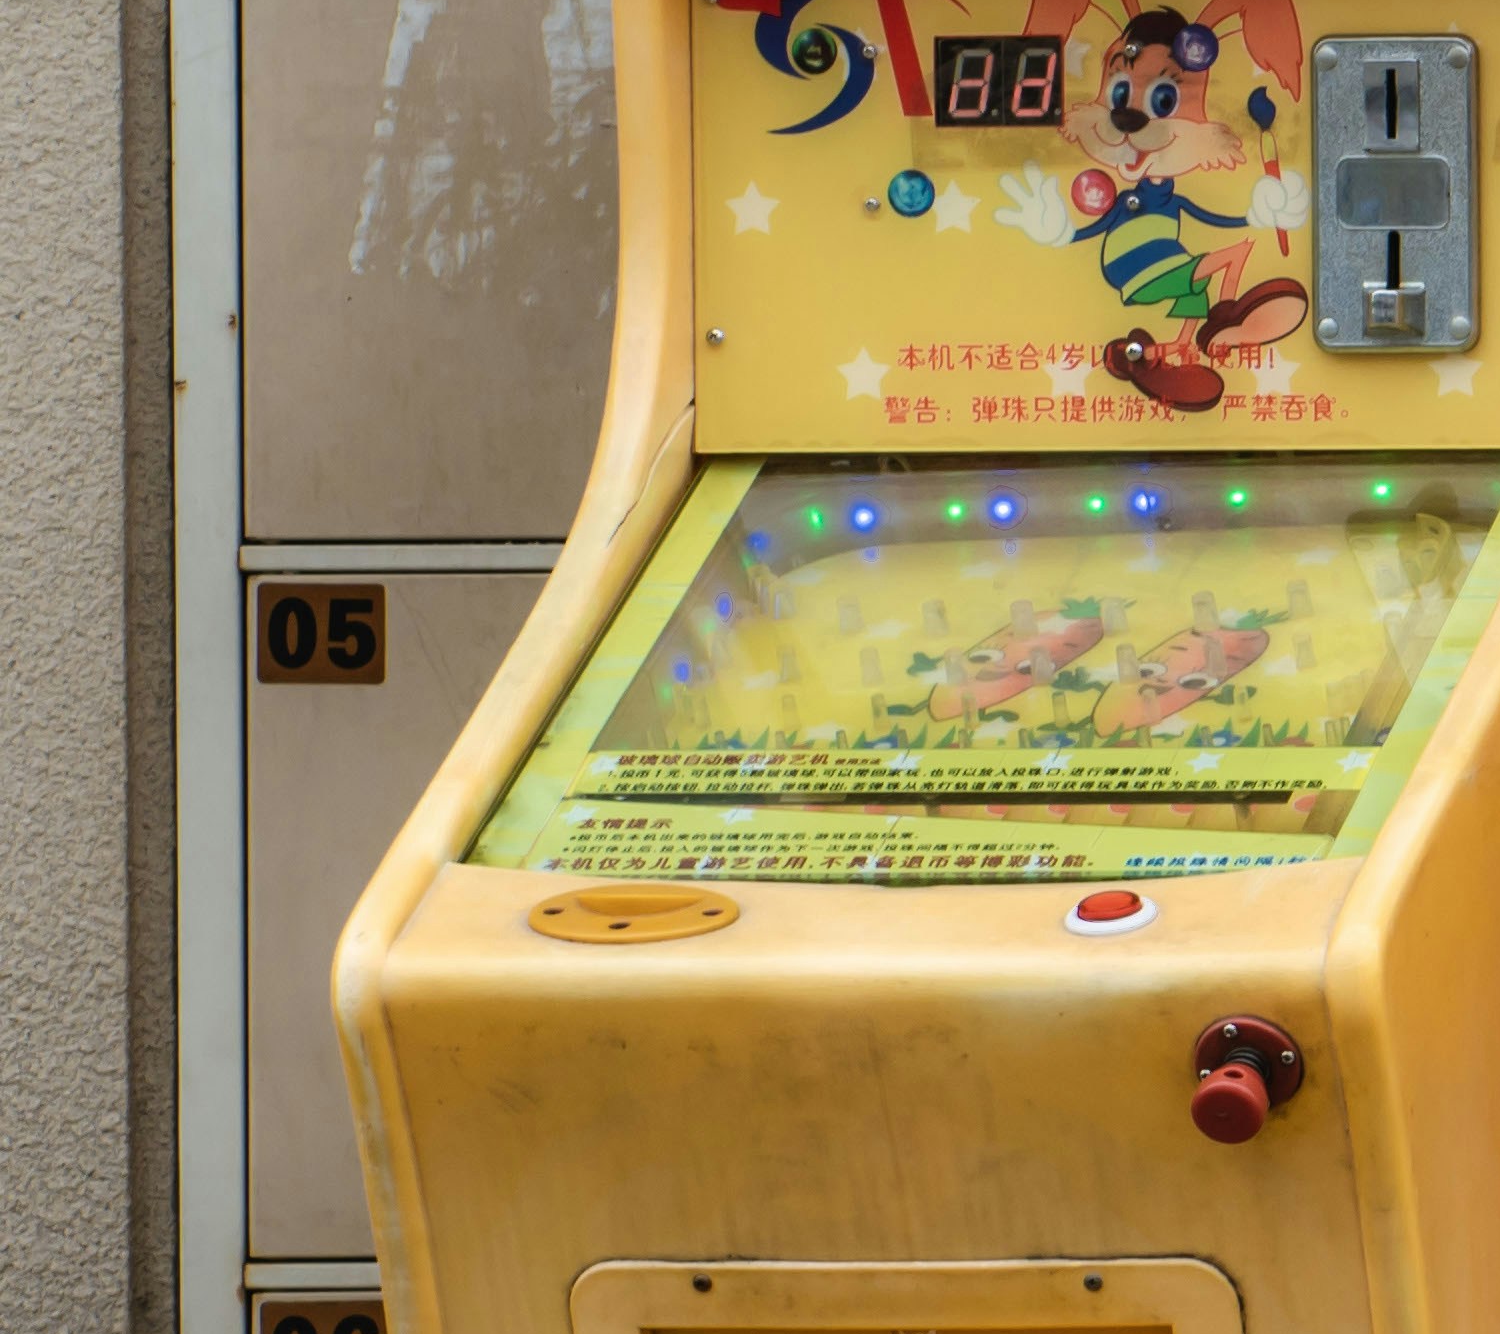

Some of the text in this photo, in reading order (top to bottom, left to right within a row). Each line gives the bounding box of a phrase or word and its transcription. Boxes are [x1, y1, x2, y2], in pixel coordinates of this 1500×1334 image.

[267, 597, 378, 670] 05
[577, 818, 673, 830] 友情提示
